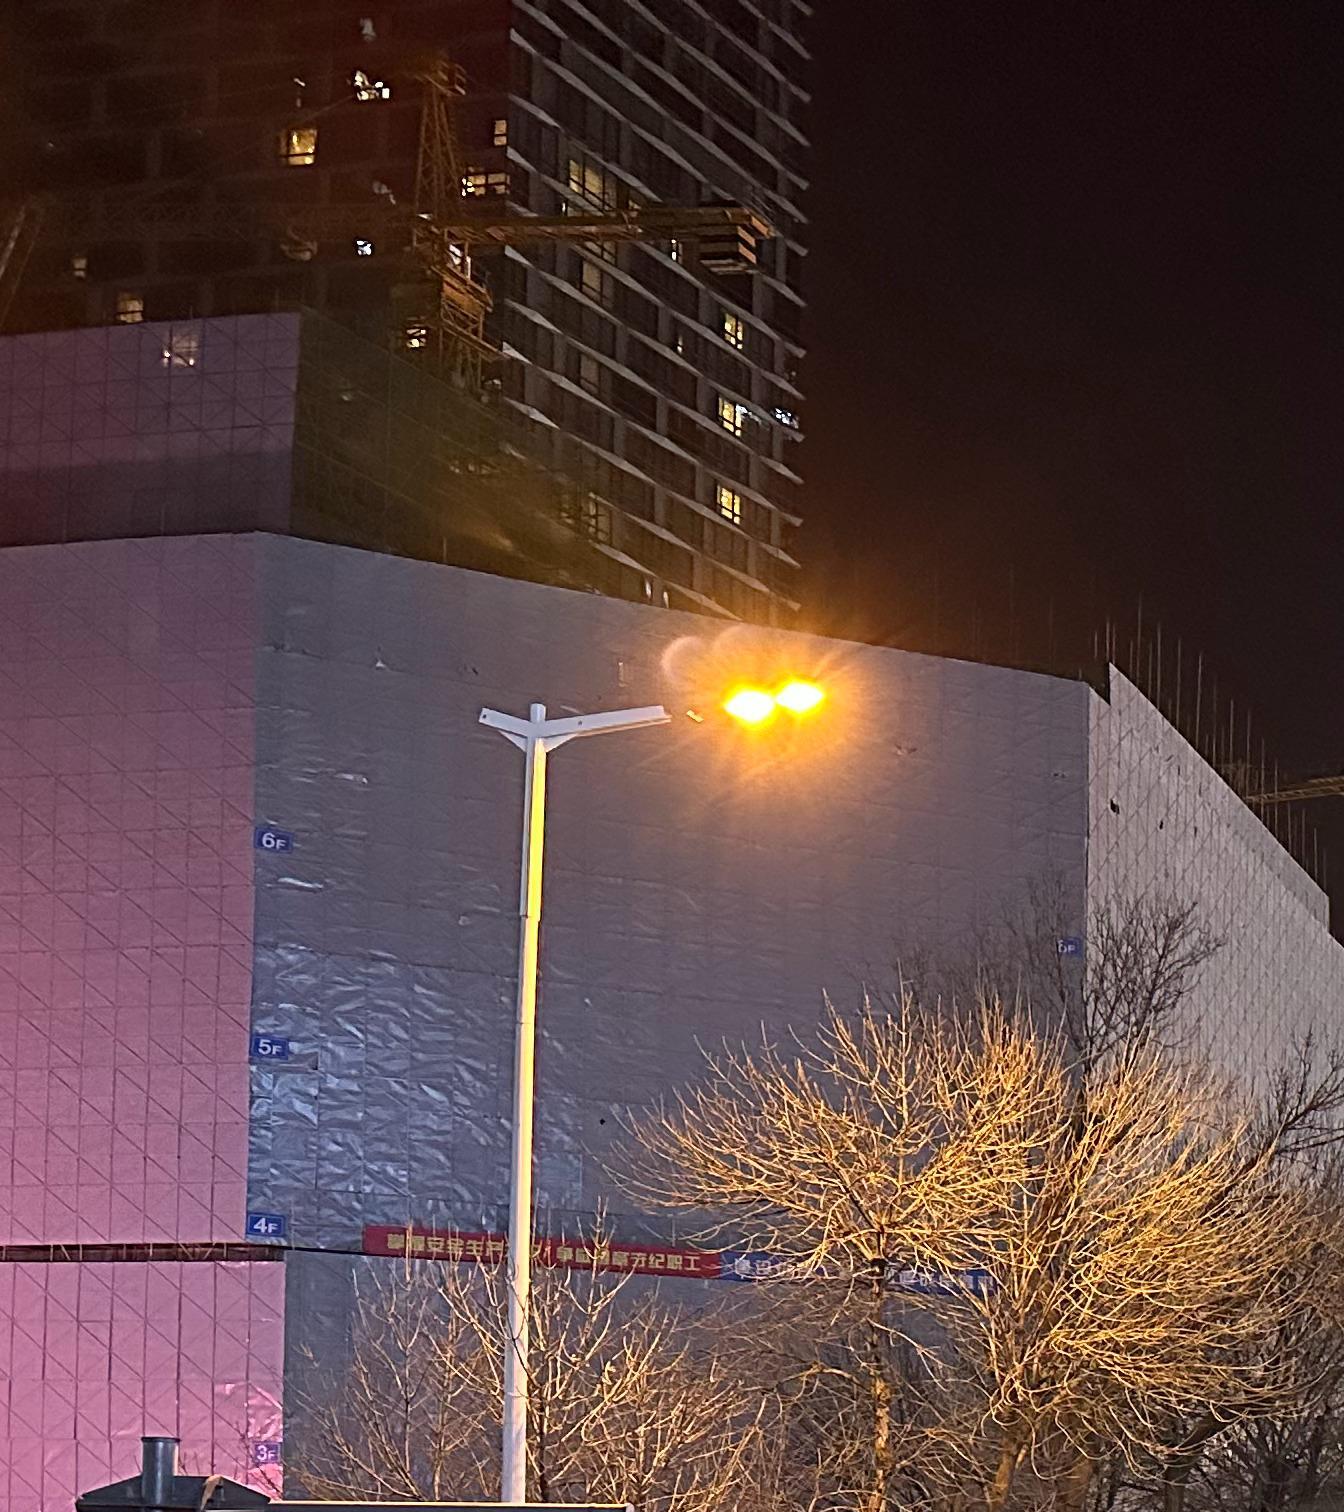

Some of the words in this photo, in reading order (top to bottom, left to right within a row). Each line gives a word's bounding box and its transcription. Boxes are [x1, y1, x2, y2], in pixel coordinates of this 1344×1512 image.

[262, 832, 287, 850] 6F
[257, 1039, 283, 1056] 5F
[253, 1216, 278, 1234] 4F
[257, 1443, 275, 1460] 3F
